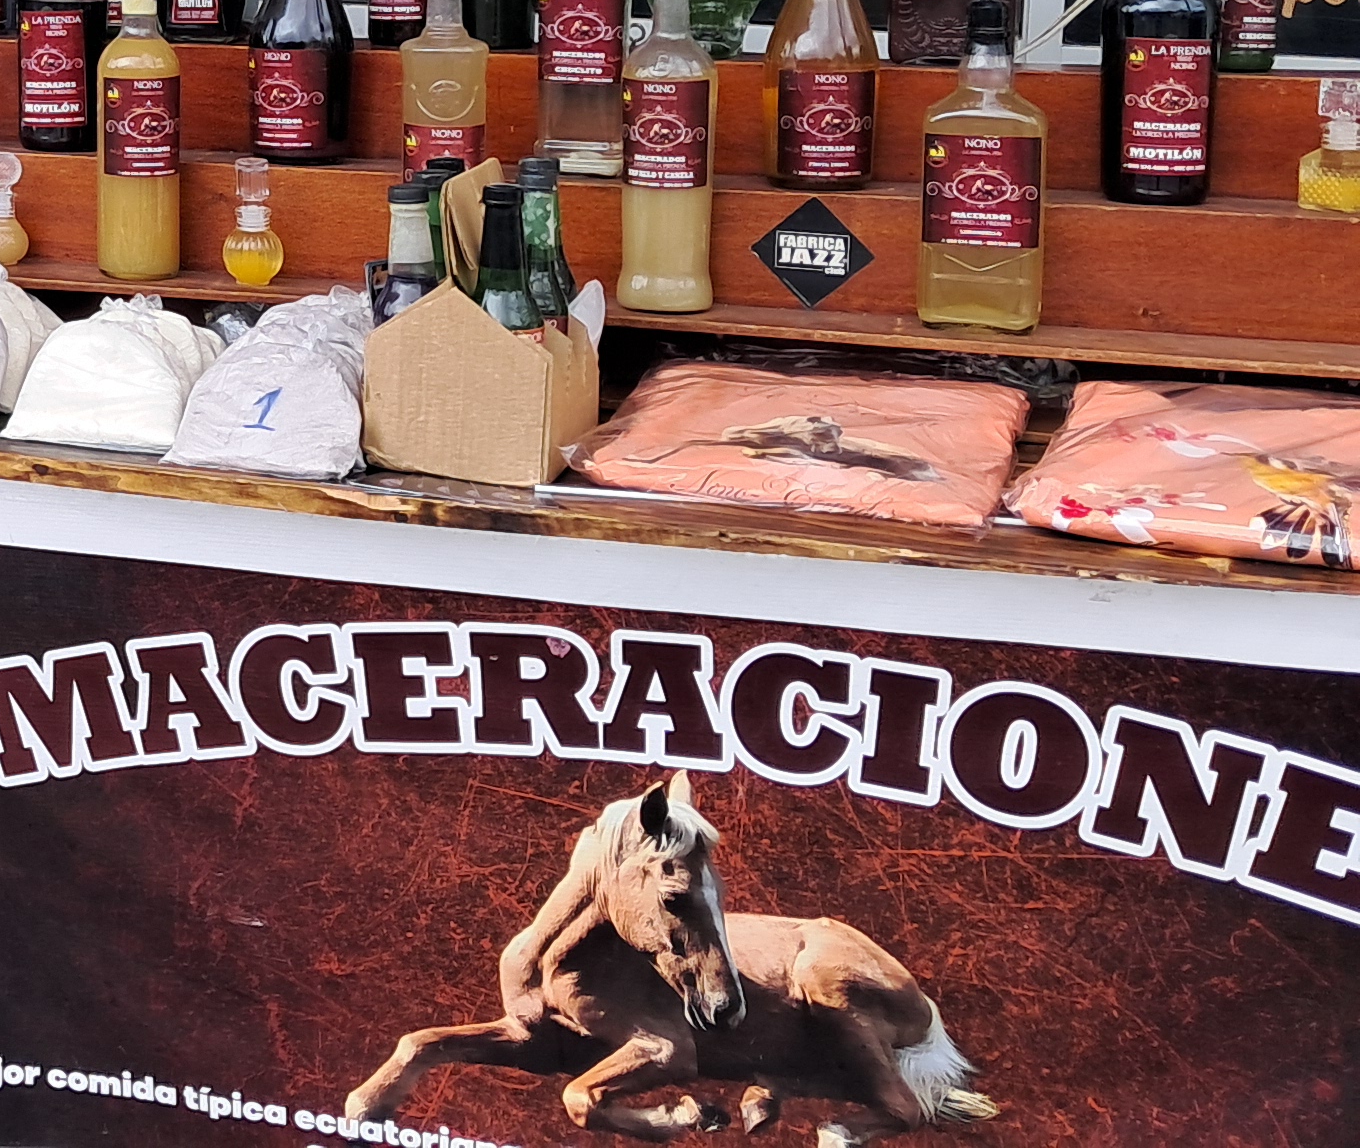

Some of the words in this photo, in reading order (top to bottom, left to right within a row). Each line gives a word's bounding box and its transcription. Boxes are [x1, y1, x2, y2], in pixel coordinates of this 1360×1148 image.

[1151, 45, 1168, 55] LA
[1170, 45, 1211, 56] PRENDA
[133, 80, 162, 89] NONO
[814, 74, 848, 84] NONO
[643, 83, 676, 93] NONO
[431, 128, 463, 139] NONO
[964, 138, 1001, 149] NONO
[1129, 145, 1203, 159] MOTILÓN
[779, 234, 846, 250] FABRICA
[778, 247, 846, 268] JAZZ
[242, 386, 283, 431] 1
[47, 1063, 178, 1108] comida
[183, 1085, 288, 1126] típica
